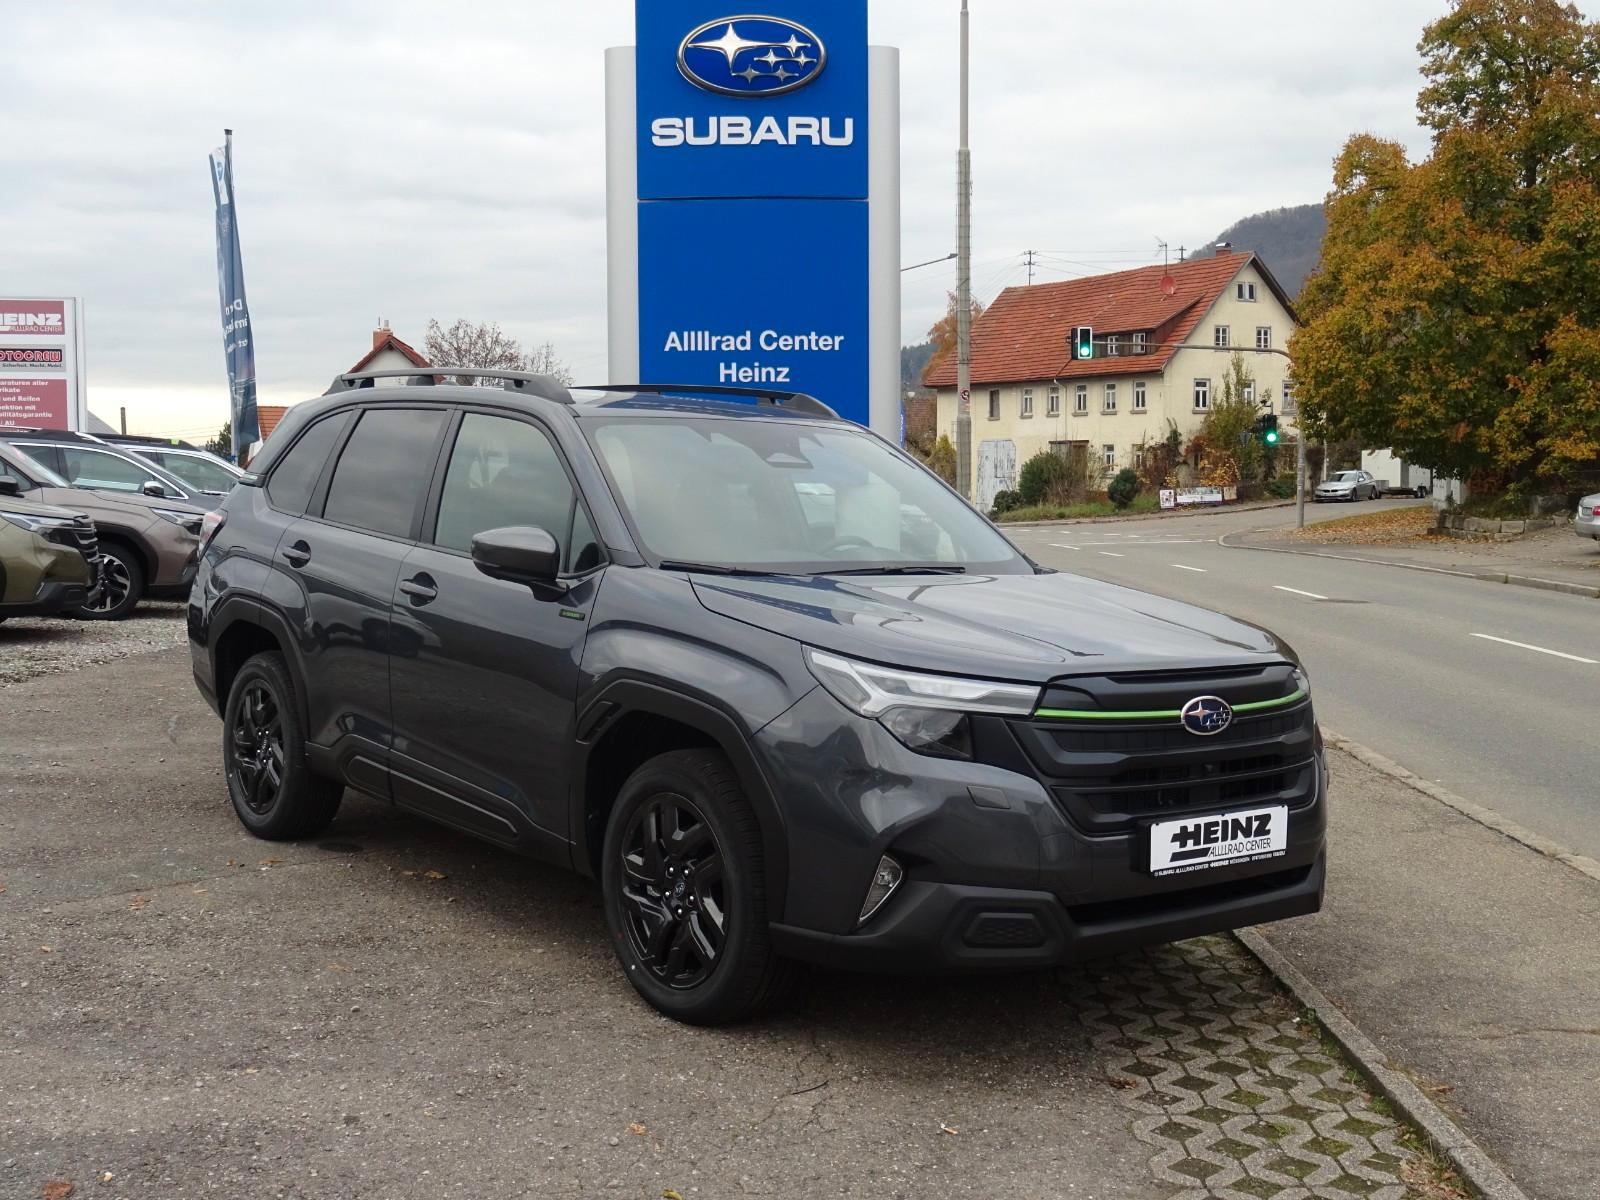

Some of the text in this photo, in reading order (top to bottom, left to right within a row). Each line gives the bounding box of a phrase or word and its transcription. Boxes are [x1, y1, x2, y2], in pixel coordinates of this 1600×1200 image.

[651, 116, 853, 146] SUBARU
[0, 313, 62, 326] EINZ
[664, 330, 844, 351] Allllrad Center
[719, 362, 790, 382] Heinz
[1170, 813, 1272, 848] HEINZ
[1245, 837, 1272, 852] CENTER
